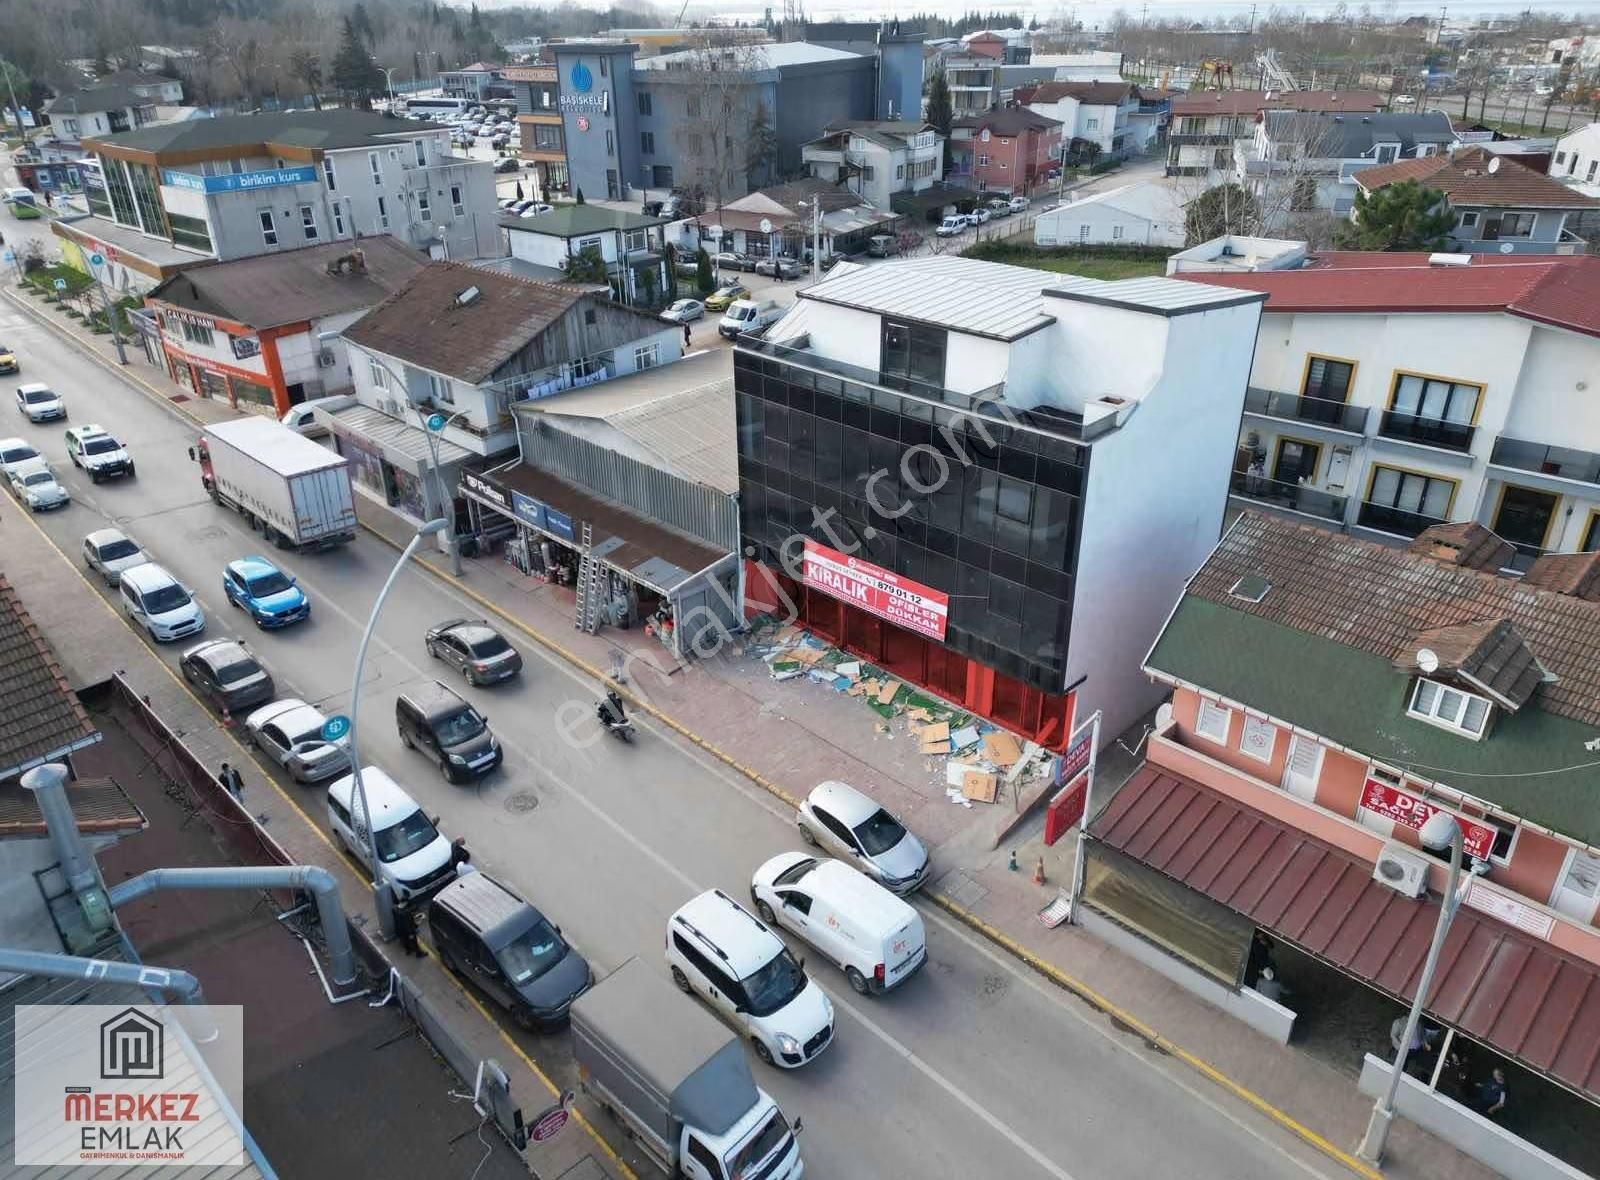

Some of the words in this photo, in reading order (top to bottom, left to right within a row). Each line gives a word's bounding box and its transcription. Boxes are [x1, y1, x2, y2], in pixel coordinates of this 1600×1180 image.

[240, 174, 276, 187] birikim
[279, 171, 301, 182] kurs
[877, 581, 895, 594] 879
[896, 589, 908, 599] 01
[909, 594, 922, 605] 12
[1370, 798, 1423, 825] SAĞLK
